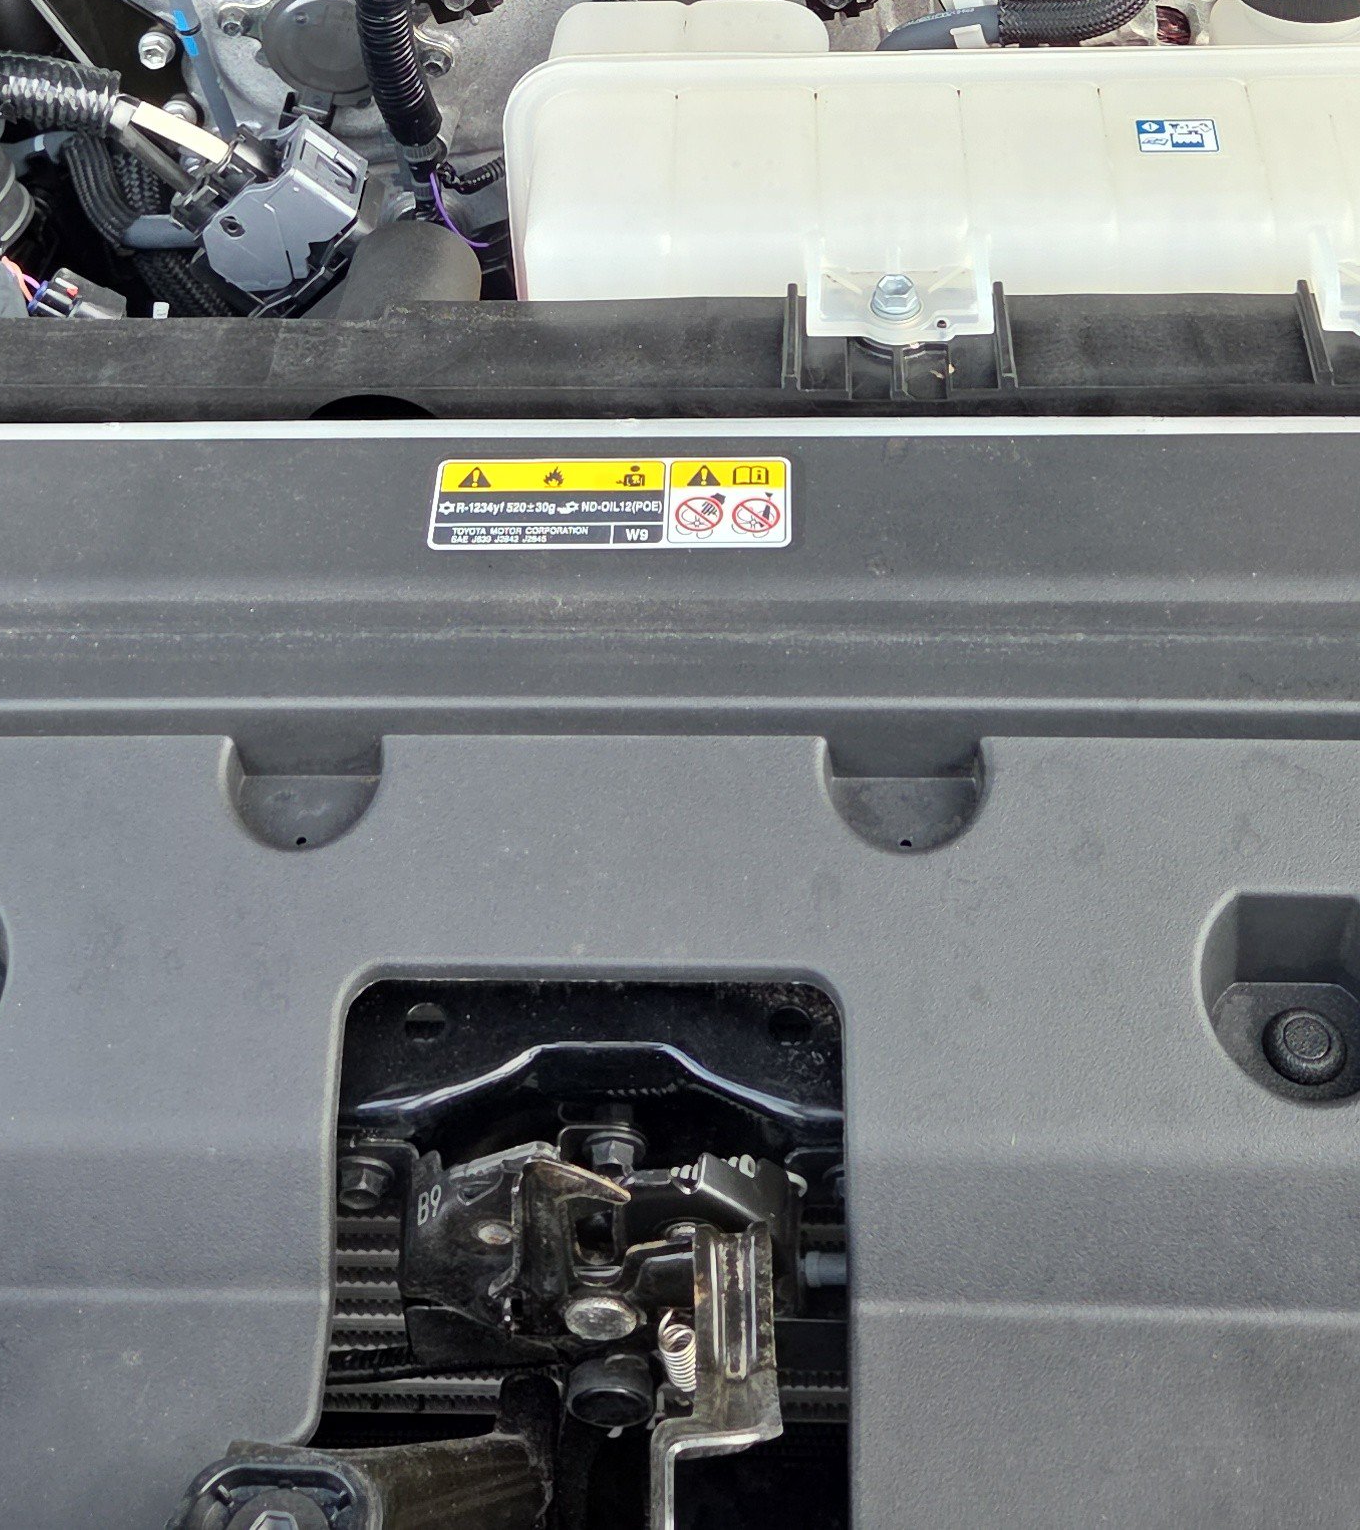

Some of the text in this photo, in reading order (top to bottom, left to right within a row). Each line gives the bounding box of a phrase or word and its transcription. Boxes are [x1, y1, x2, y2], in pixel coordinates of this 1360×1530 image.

[455, 500, 663, 516] R-1234yf 520±30g ND-OIL12(POE)
[452, 526, 589, 535] TOYOTA MOTOR CORPORATION
[625, 528, 649, 542] W9
[417, 1184, 442, 1226] B9
